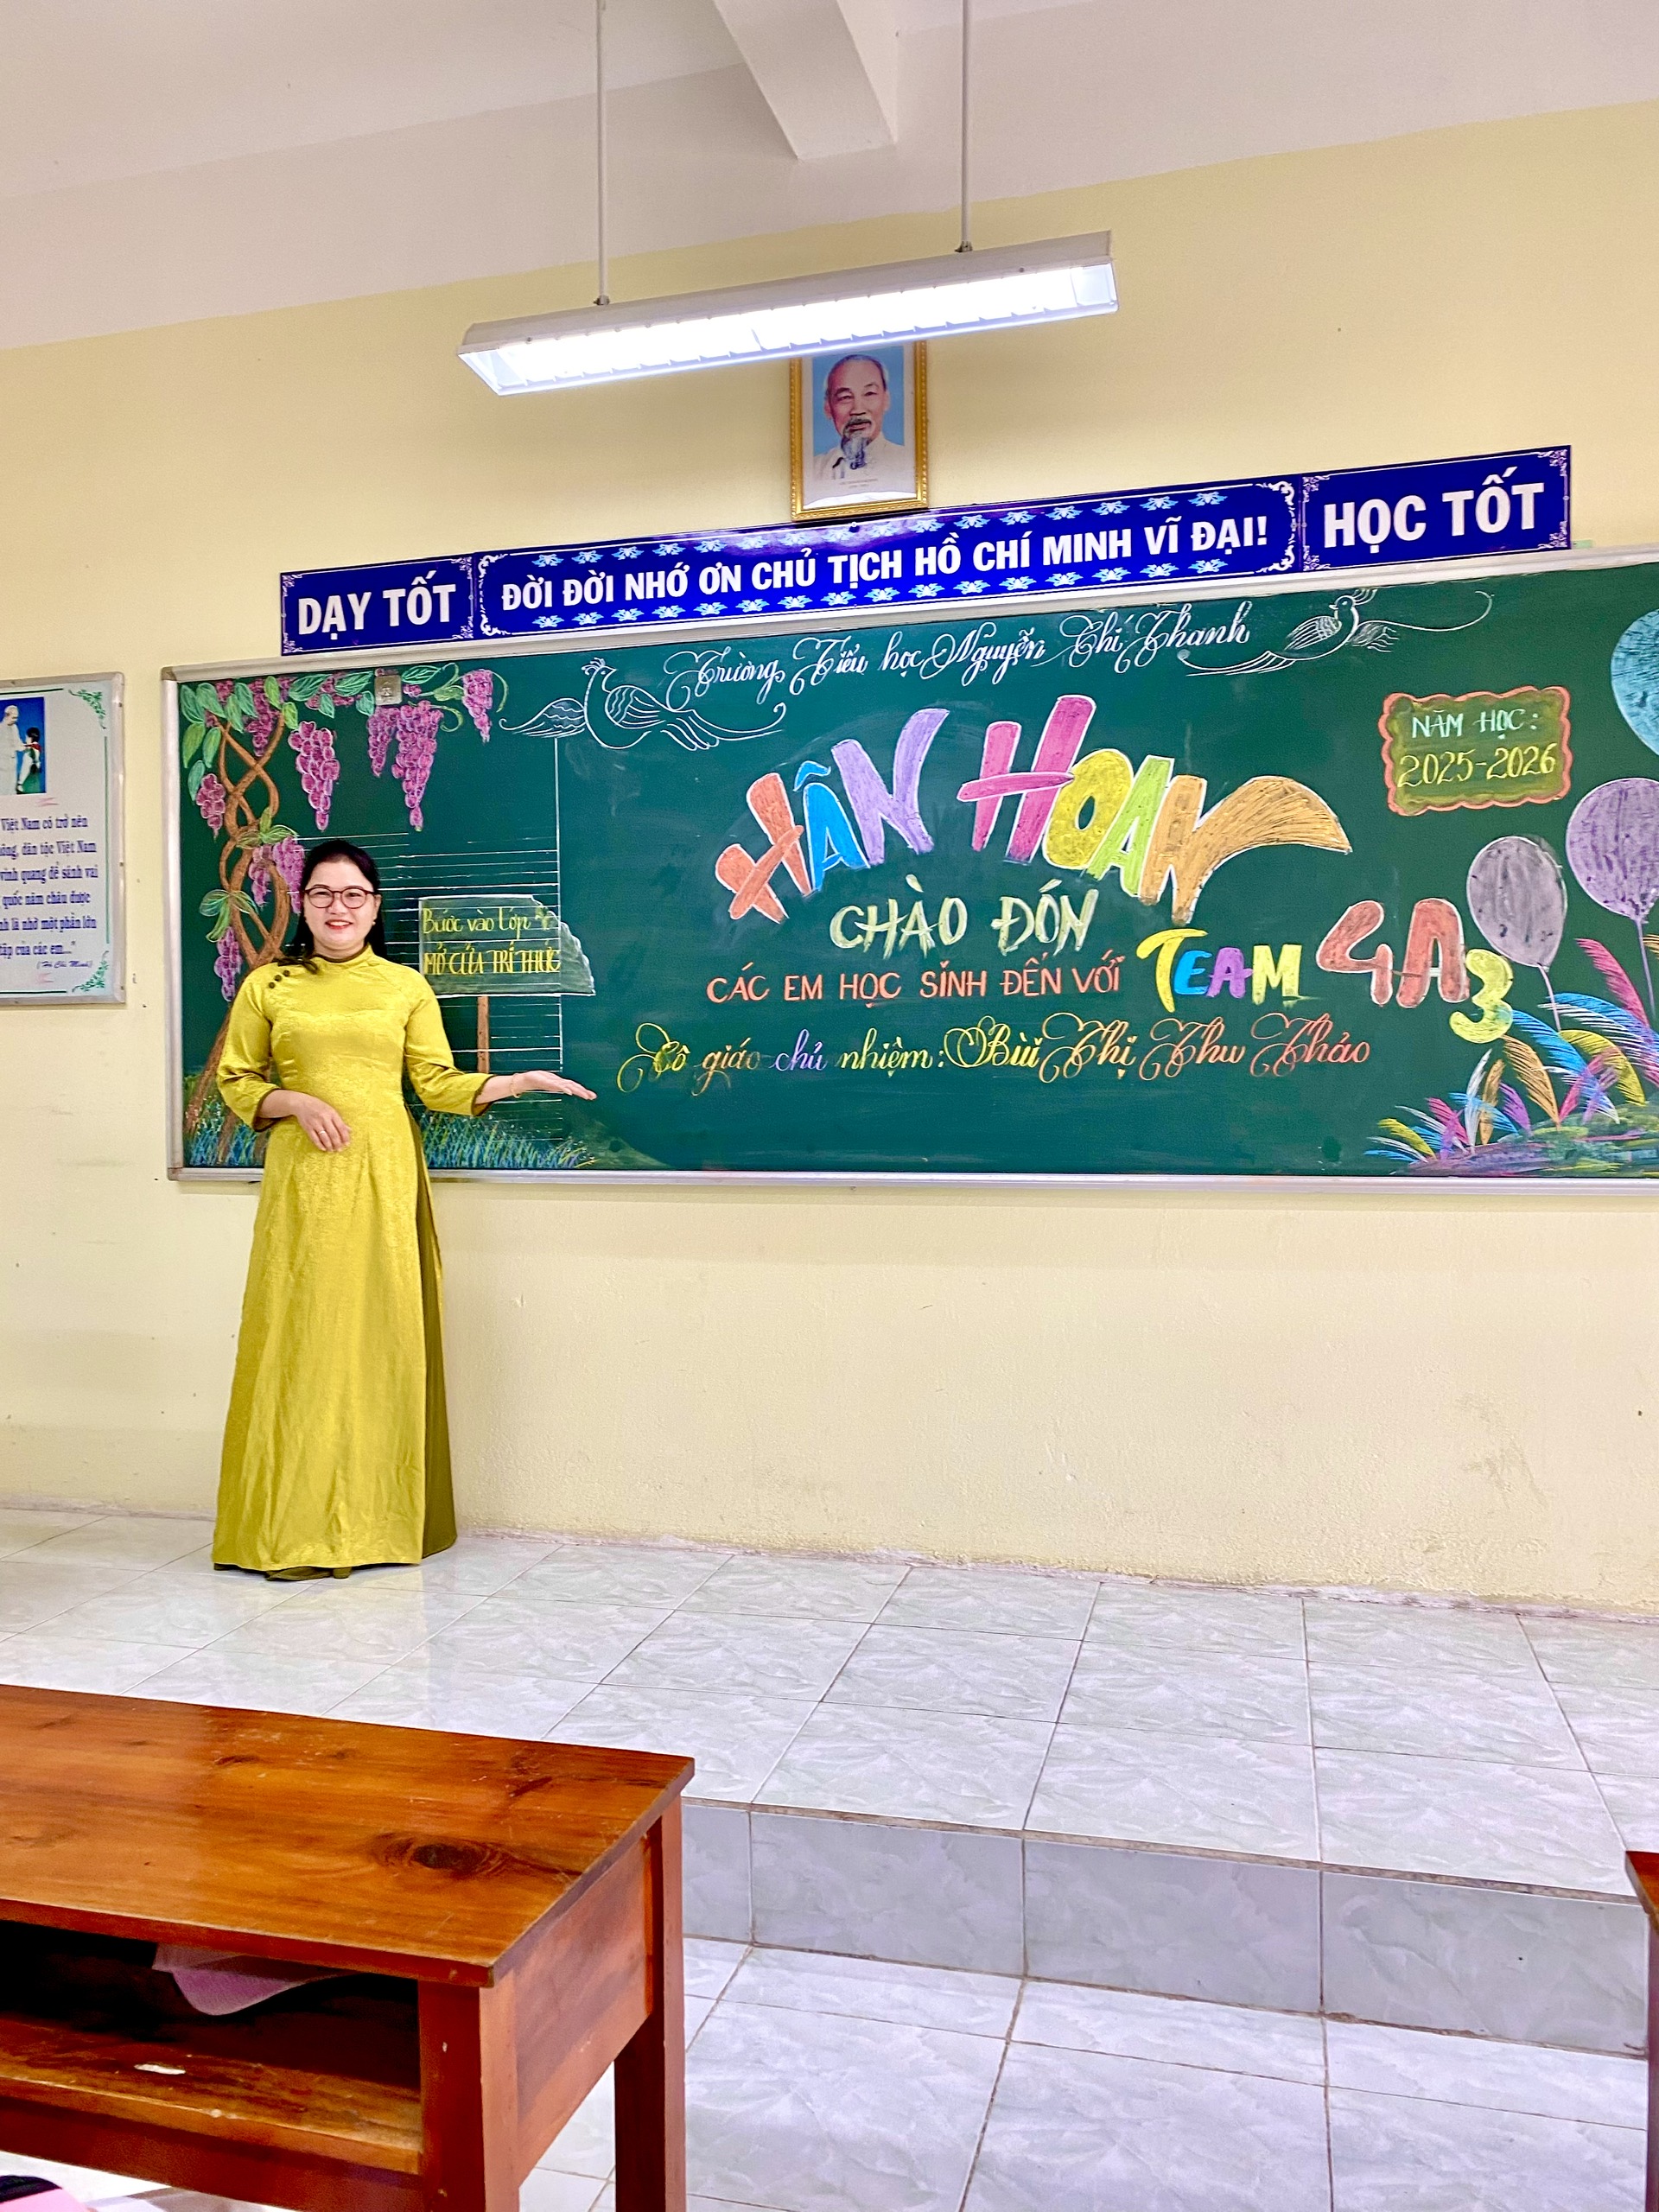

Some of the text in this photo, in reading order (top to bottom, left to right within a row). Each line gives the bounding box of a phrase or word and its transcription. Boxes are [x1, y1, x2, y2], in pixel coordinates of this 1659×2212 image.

[1323, 466, 1545, 554] HỌC TỐT
[502, 515, 1268, 612] ĐỜI ĐỜI NHỚ ƠN CHỦ TỊCH HỒ CHÍ MINH VĨ ĐẠI!
[298, 570, 456, 640] DẠY TỐT
[663, 601, 1253, 711] Trường Tiểu học Nguyễn Chí Thanh
[1411, 709, 1539, 740] NĂM HỌC:
[1397, 742, 1558, 788] 2025-2026
[21, 817, 41, 830] Nam
[956, 694, 1353, 925] HOAN
[21, 868, 47, 885] quang
[76, 840, 97, 853] Nam
[423, 907, 464, 934] Bước
[467, 908, 495, 932] vào
[830, 874, 1099, 959] CHÀO ĐÓN
[705, 962, 770, 1003] CÁC
[783, 973, 823, 1001] EM
[840, 972, 901, 1008] HỌC
[1000, 952, 1062, 996] ĐẾN
[1071, 949, 1126, 993] VỚI
[1136, 928, 1305, 1014] TEAM
[616, 1023, 690, 1094] Cô
[692, 1037, 761, 1096] giáo
[768, 1028, 828, 1071] chủ
[944, 1015, 1041, 1069] Bùi
[1038, 1012, 1137, 1084] Thị
[1138, 1016, 1246, 1083] Thu
[1249, 1012, 1371, 1077] Thảo
